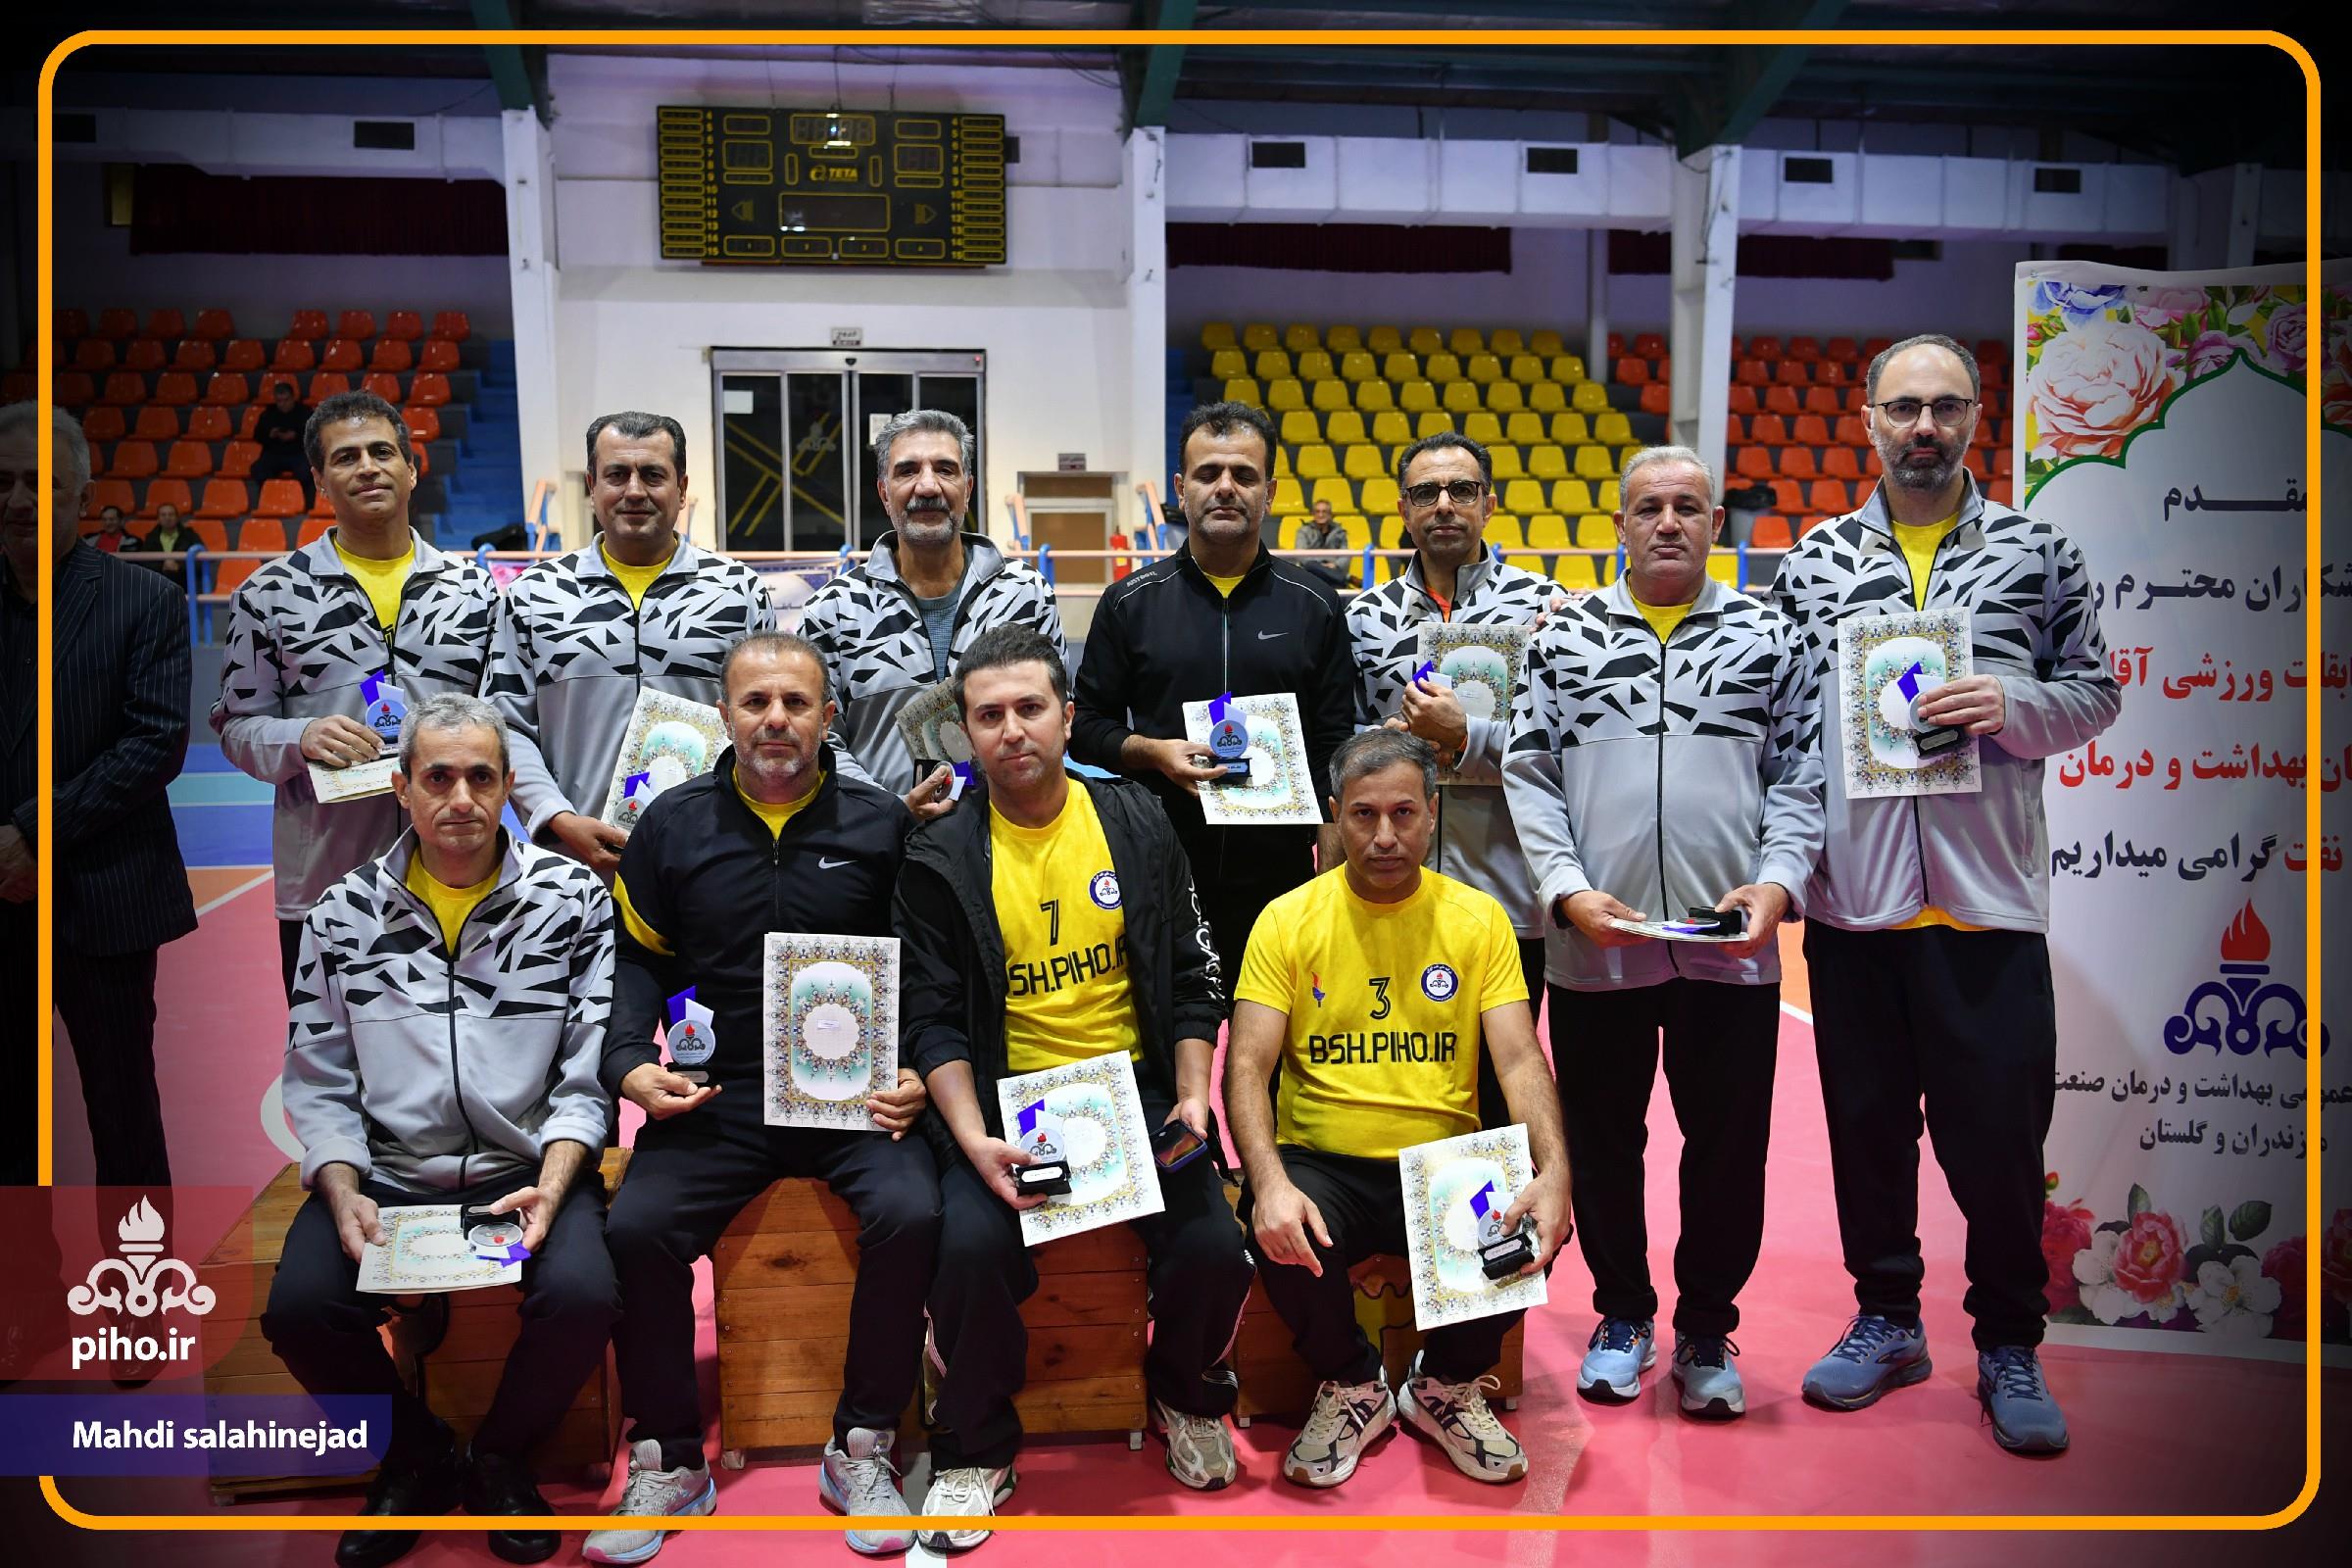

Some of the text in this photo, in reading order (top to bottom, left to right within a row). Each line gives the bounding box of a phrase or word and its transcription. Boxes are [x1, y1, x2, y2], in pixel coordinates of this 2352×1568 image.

[828, 168, 858, 178] TETA
[2116, 568, 2235, 610] محترم
[2163, 653, 2273, 702] ورزشی
[2060, 740, 2154, 789] درمان
[2164, 758, 2180, 790] و
[2192, 743, 2307, 789] بهداشت
[2052, 830, 2167, 878] میداریم
[2178, 832, 2278, 881] گرامی
[1041, 899, 1059, 946] 7
[1369, 976, 1391, 1020] 3
[1308, 1032, 1457, 1064] BSH.PIHO.IR
[2112, 1070, 2171, 1103] درمان
[2177, 1080, 2187, 1103] و
[2194, 1074, 2273, 1107] بهداشت
[2139, 1118, 2328, 1159] مزندران و گلستان
